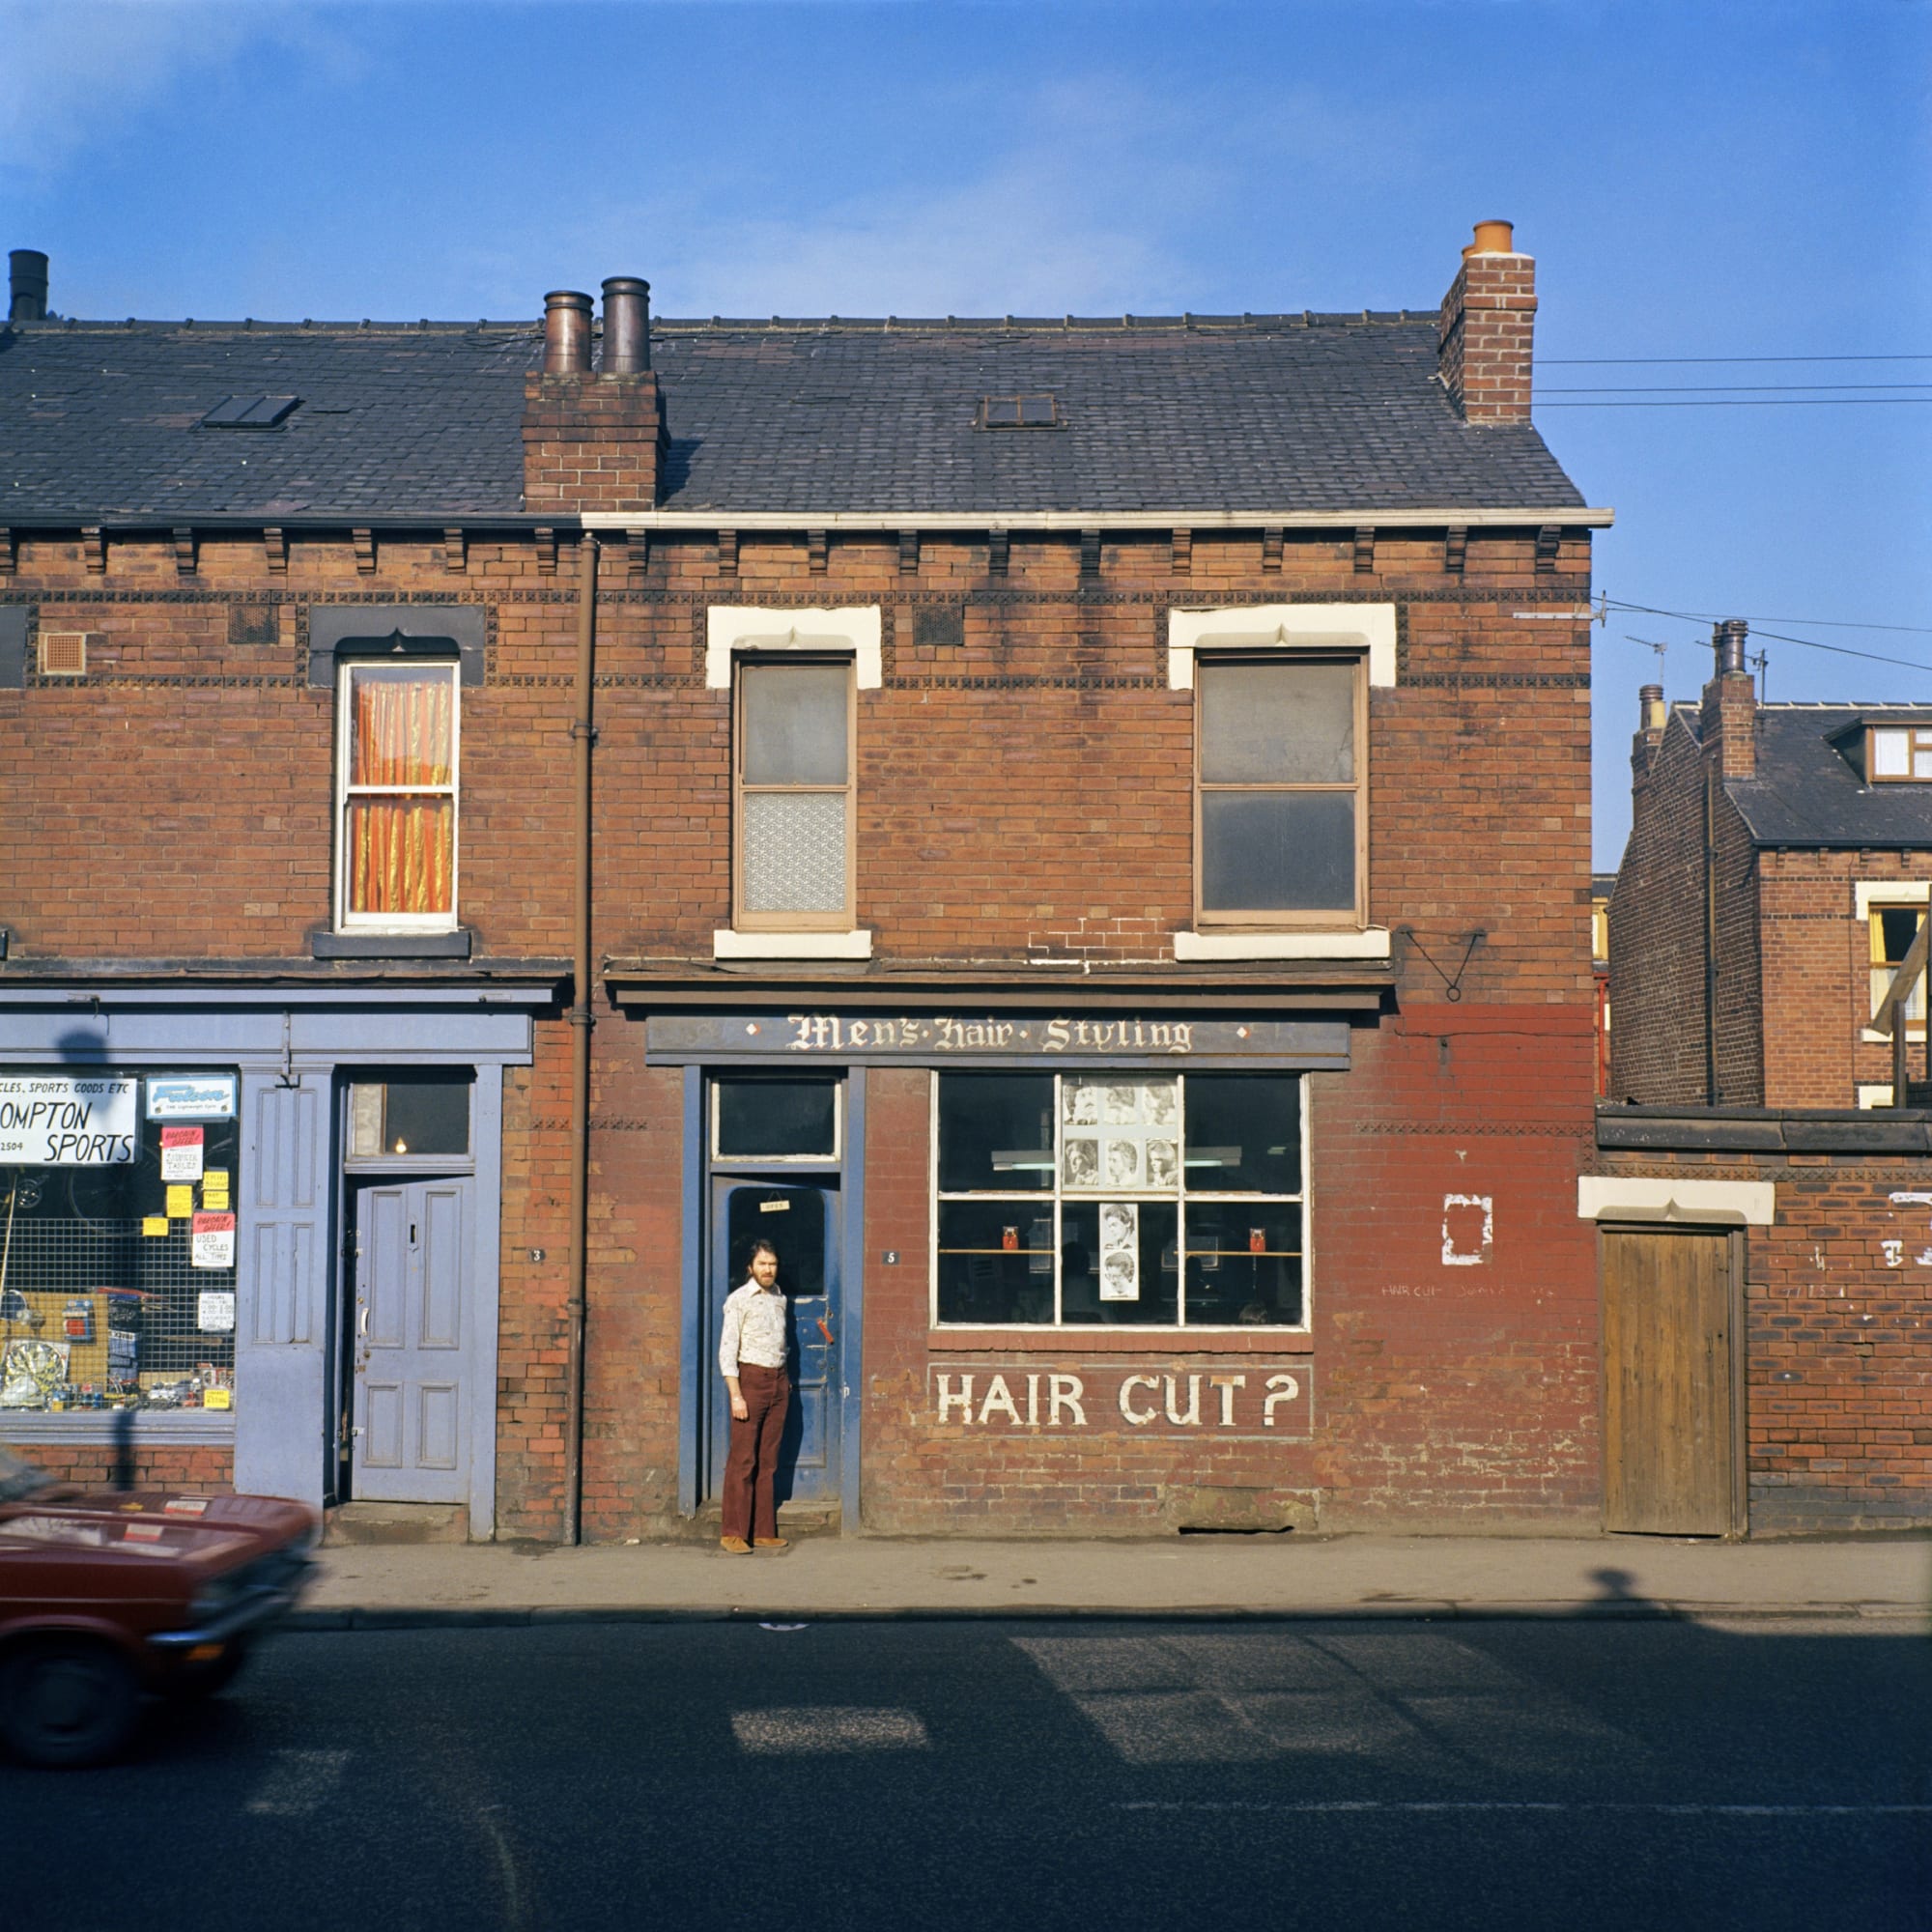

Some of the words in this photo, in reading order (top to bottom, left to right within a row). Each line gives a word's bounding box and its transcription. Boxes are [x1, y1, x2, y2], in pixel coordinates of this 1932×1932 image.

[785, 1014, 919, 1051] Men's
[1039, 1016, 1193, 1053] Styling
[29, 1082, 69, 1093] SPORTS
[108, 1083, 129, 1094] ETC
[43, 1134, 133, 1162] SPORTS
[196, 1235, 217, 1243] USED
[533, 1249, 541, 1262] 3
[888, 1252, 895, 1264] 5
[937, 1374, 1089, 1426] HAIR
